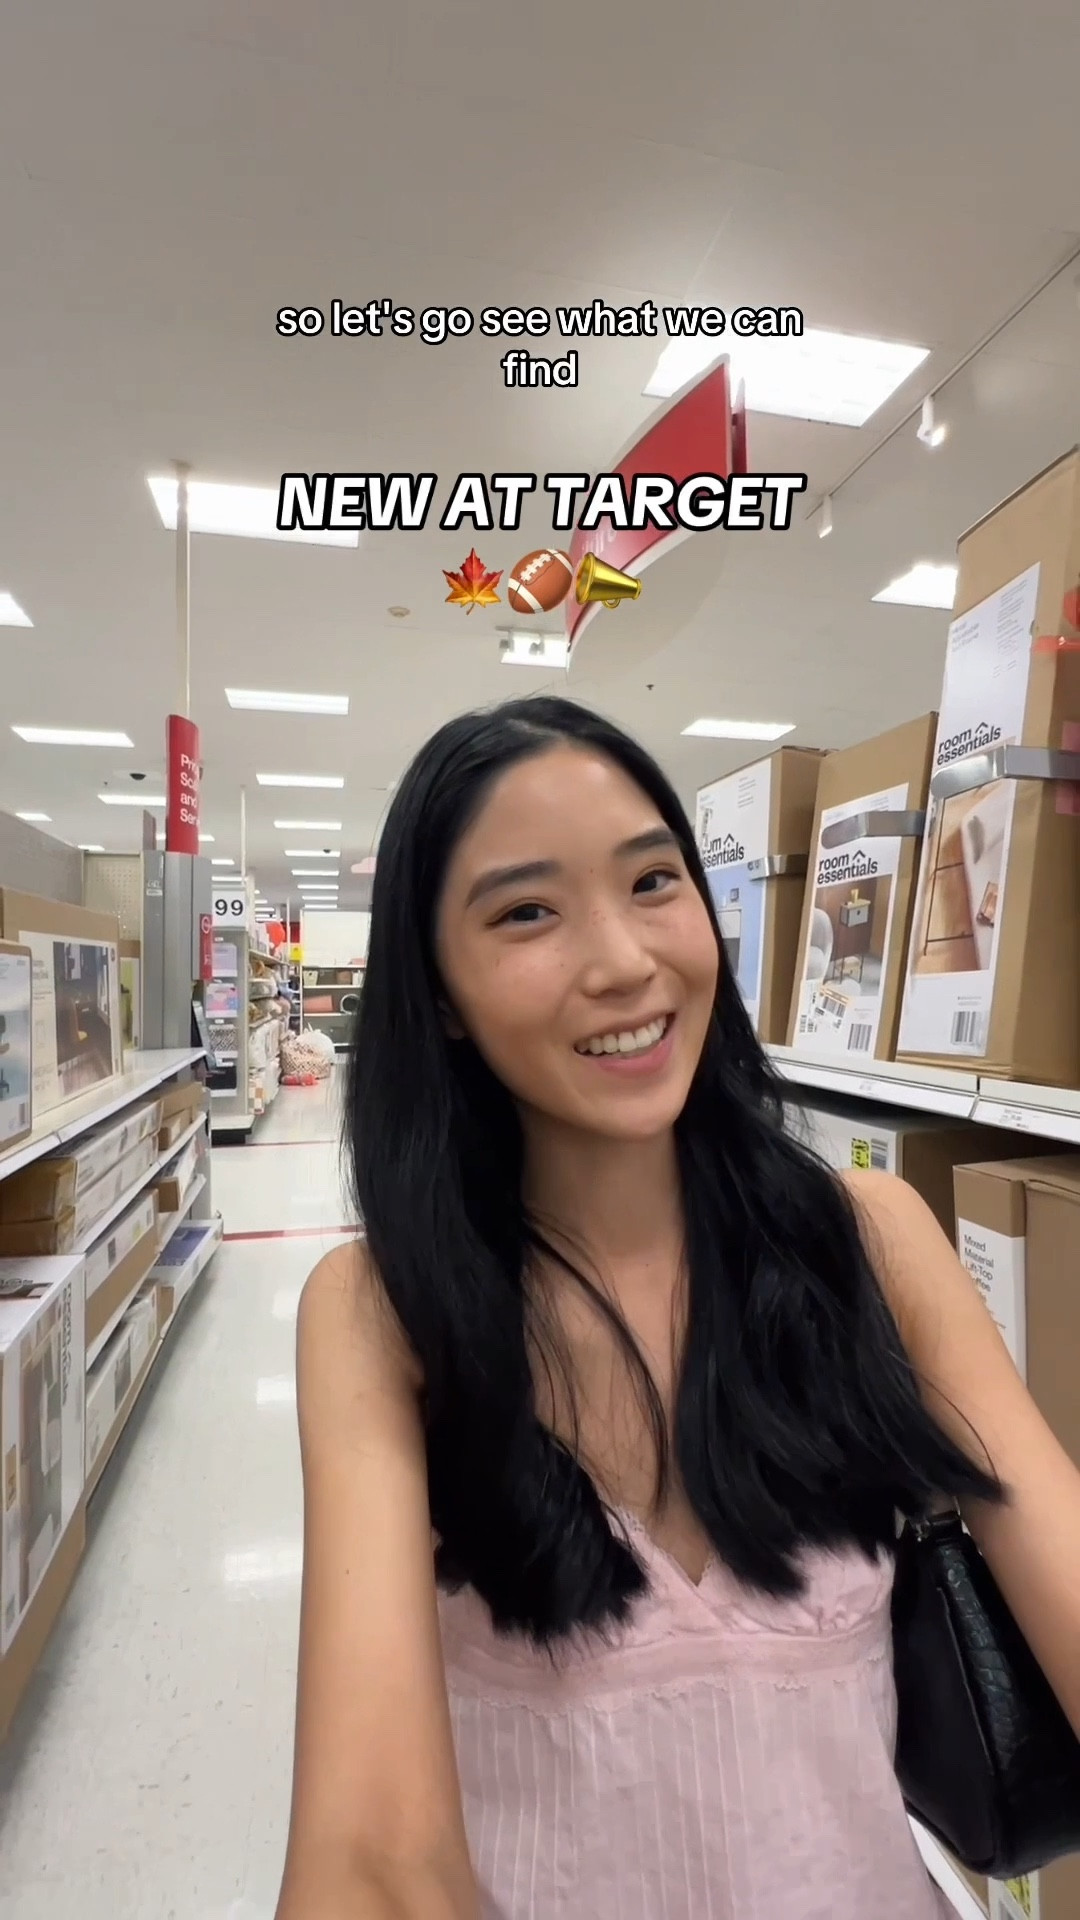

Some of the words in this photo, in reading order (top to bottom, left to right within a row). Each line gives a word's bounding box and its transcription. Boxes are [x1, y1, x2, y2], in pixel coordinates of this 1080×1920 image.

[937, 725, 1002, 766] essentials
[938, 727, 972, 754] room
[817, 857, 878, 885] essentials
[818, 853, 850, 872] room
[214, 898, 244, 917] 99
[963, 1233, 986, 1253] Mixed
[964, 1246, 994, 1269] Material
